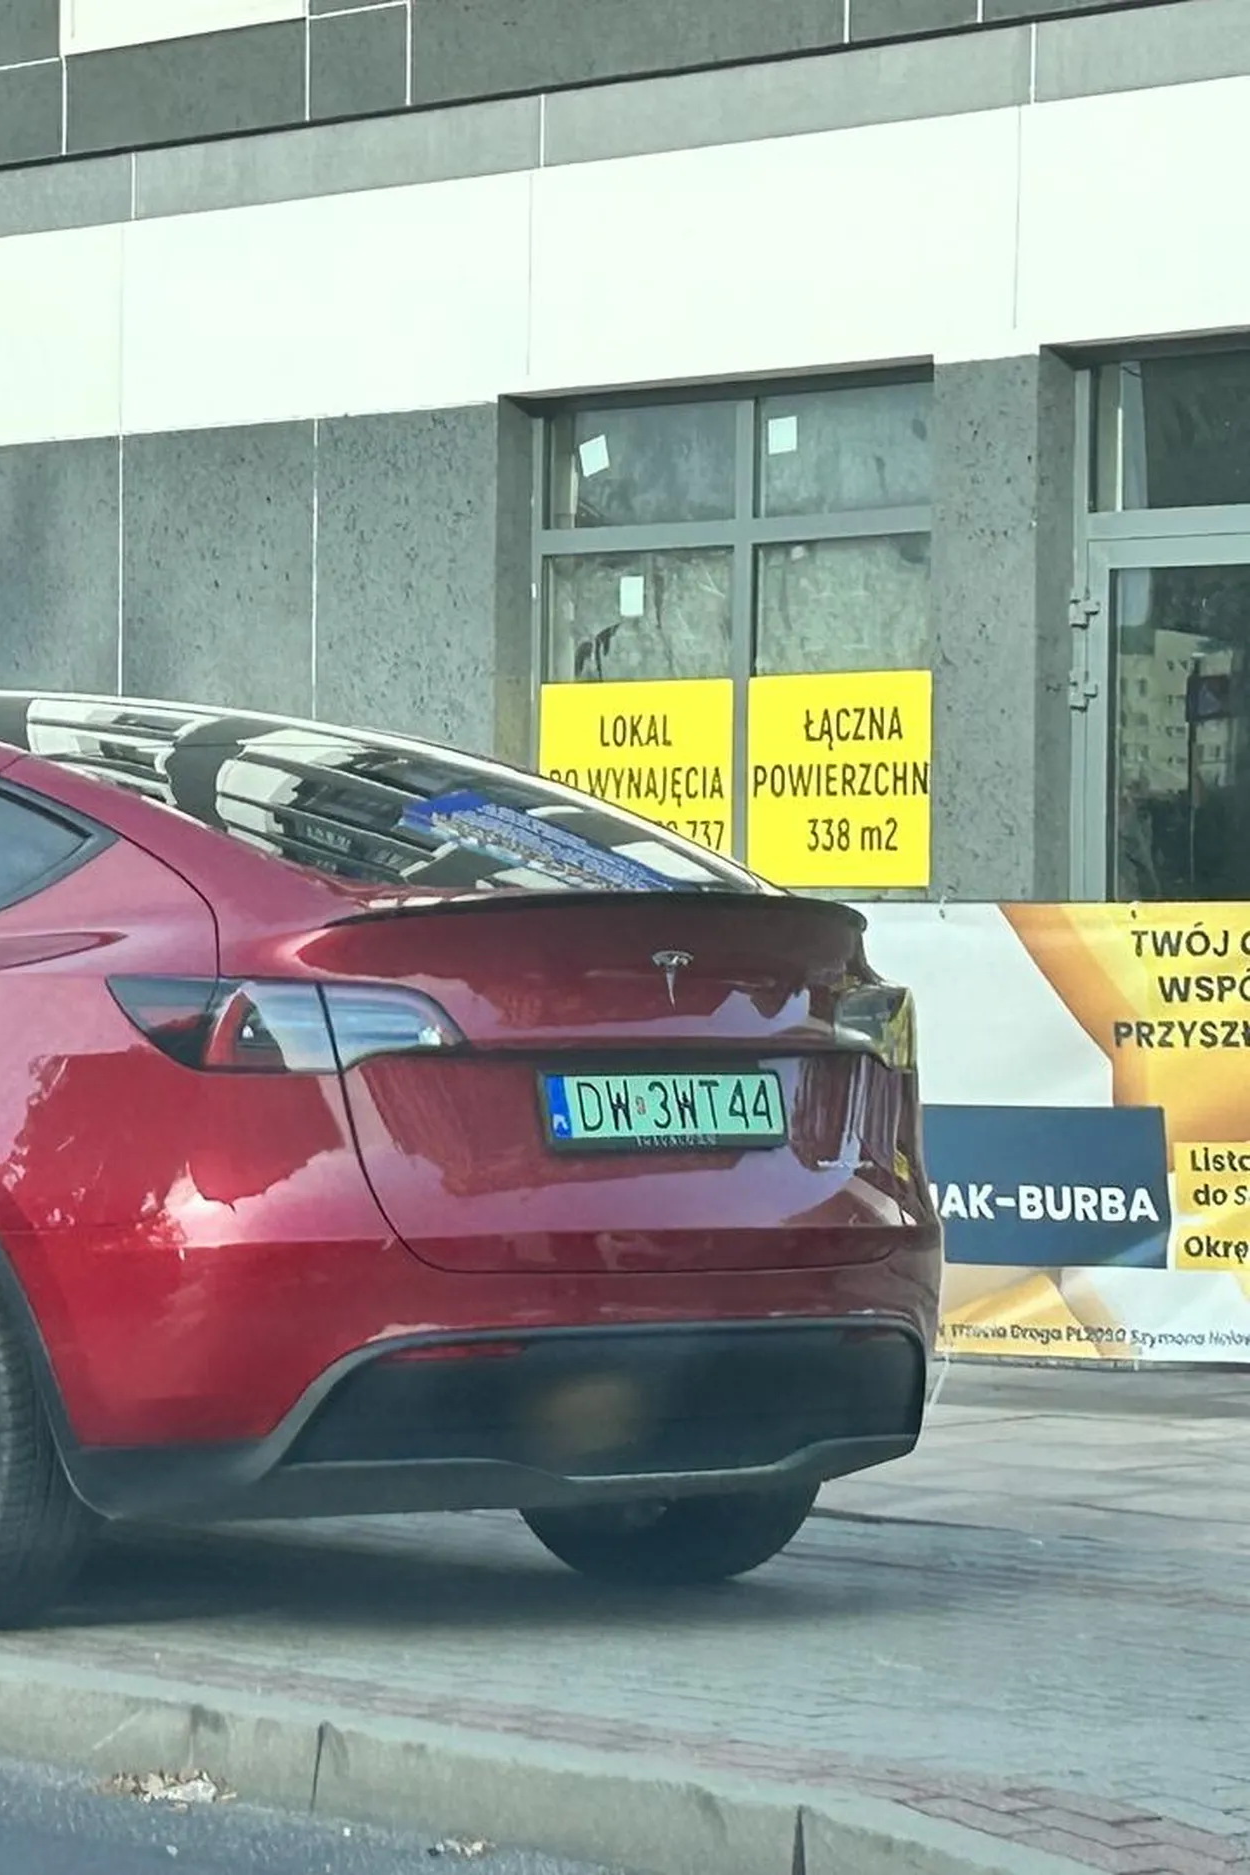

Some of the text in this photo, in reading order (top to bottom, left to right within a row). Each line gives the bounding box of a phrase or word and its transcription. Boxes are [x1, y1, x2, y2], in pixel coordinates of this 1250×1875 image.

[599, 714, 673, 748] LOKAL
[804, 706, 903, 751] ŁĄCZNA
[588, 765, 725, 808] WYNAJĘCIA
[753, 762, 928, 798] POWIERZCHN
[807, 817, 898, 852] 338 m2
[1130, 921, 1229, 957] TWÓJ
[576, 1078, 773, 1131] DW 3WT44
[1193, 1183, 1250, 1207] do S
[950, 1323, 1007, 1340] Tria
